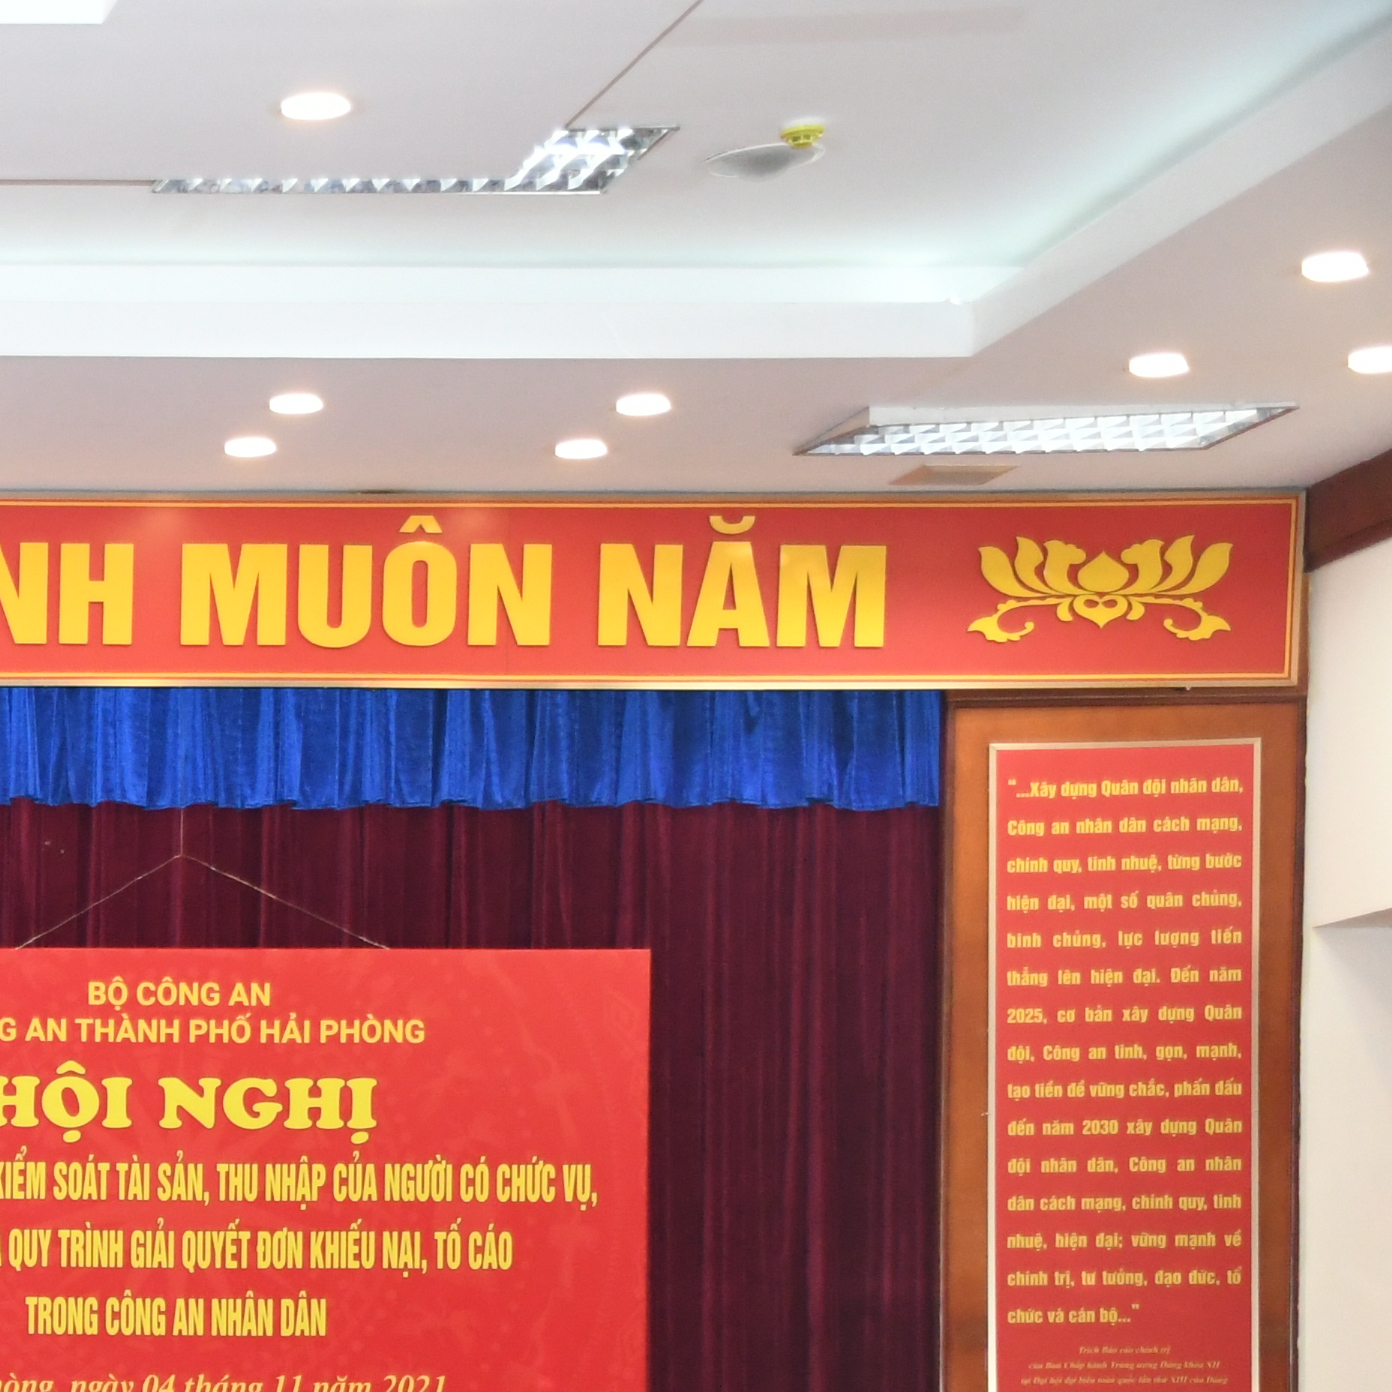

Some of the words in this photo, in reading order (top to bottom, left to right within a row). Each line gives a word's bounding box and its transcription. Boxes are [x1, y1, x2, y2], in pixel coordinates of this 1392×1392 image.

[180, 514, 553, 649] MUÔN
[597, 514, 888, 648] NĂM
[88, 976, 128, 1010] BỘ
[137, 976, 220, 1006] CÔNG
[228, 982, 270, 1006] AN
[25, 1018, 66, 1041] AN
[75, 1013, 180, 1042] THÀNH
[190, 1013, 251, 1043] PHỐ
[260, 1013, 310, 1043] HẢI
[320, 1014, 424, 1043] PHÒNG
[158, 1078, 377, 1144] NGHỊ
[54, 1154, 110, 1200] SOÁT
[116, 1155, 150, 1200] TÀI
[158, 1150, 209, 1206] SẢN,
[217, 1164, 258, 1201] THU
[266, 1156, 326, 1210] NHẬP
[334, 1151, 377, 1201] CỦA
[385, 1154, 452, 1202] NGƯỜI
[460, 1156, 489, 1202] CÓ
[497, 1156, 555, 1202] CHỨC
[563, 1164, 597, 1210] VỤ,
[9, 1229, 51, 1271] QUY
[58, 1222, 123, 1267] TRÌNH
[131, 1218, 174, 1268] GIẢI
[182, 1219, 250, 1273] QUYẾT
[257, 1228, 302, 1269] ĐƠN
[310, 1219, 375, 1269] KHIẾU
[383, 1231, 427, 1277] NẠI,
[434, 1218, 461, 1269] TỐ
[469, 1224, 512, 1270] CÁO
[26, 1296, 98, 1335] TRONG
[106, 1290, 166, 1336] CÔNG
[173, 1298, 204, 1336] AN
[212, 1290, 273, 1336] NHÂN
[281, 1291, 326, 1336] DÂN
